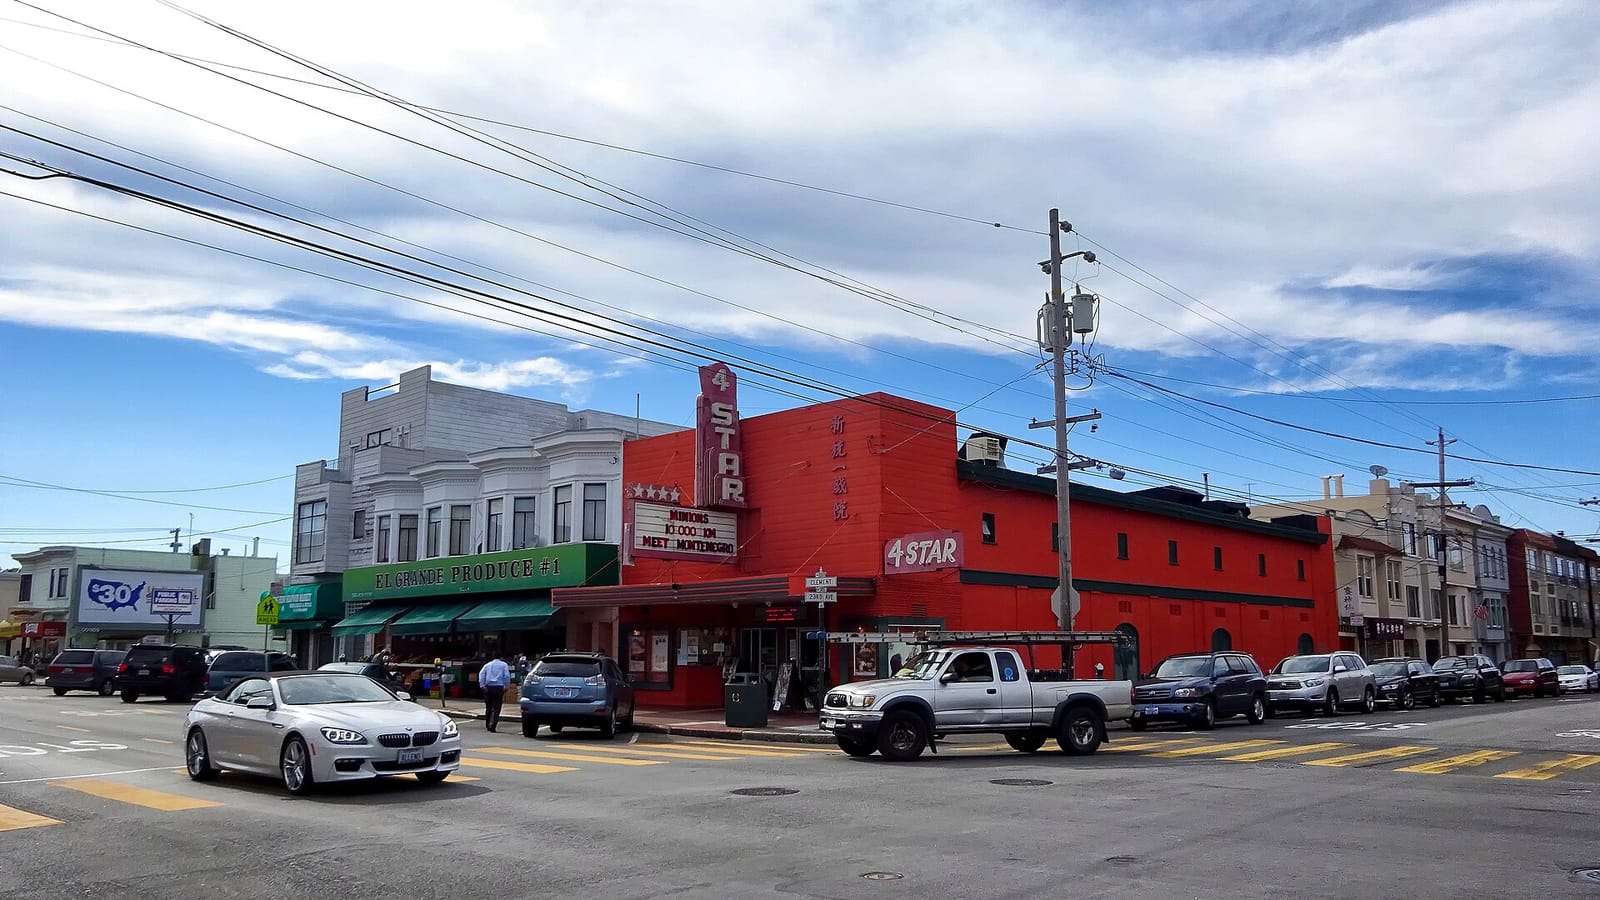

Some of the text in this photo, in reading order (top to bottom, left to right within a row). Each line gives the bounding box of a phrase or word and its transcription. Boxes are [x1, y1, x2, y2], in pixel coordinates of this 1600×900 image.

[710, 402, 745, 502] STAR
[669, 510, 709, 524] MINIONS
[643, 536, 734, 554] MEET MONTENEGRO
[375, 557, 561, 589] EL GRANDE PRODUCE #1
[91, 584, 132, 604] $30
